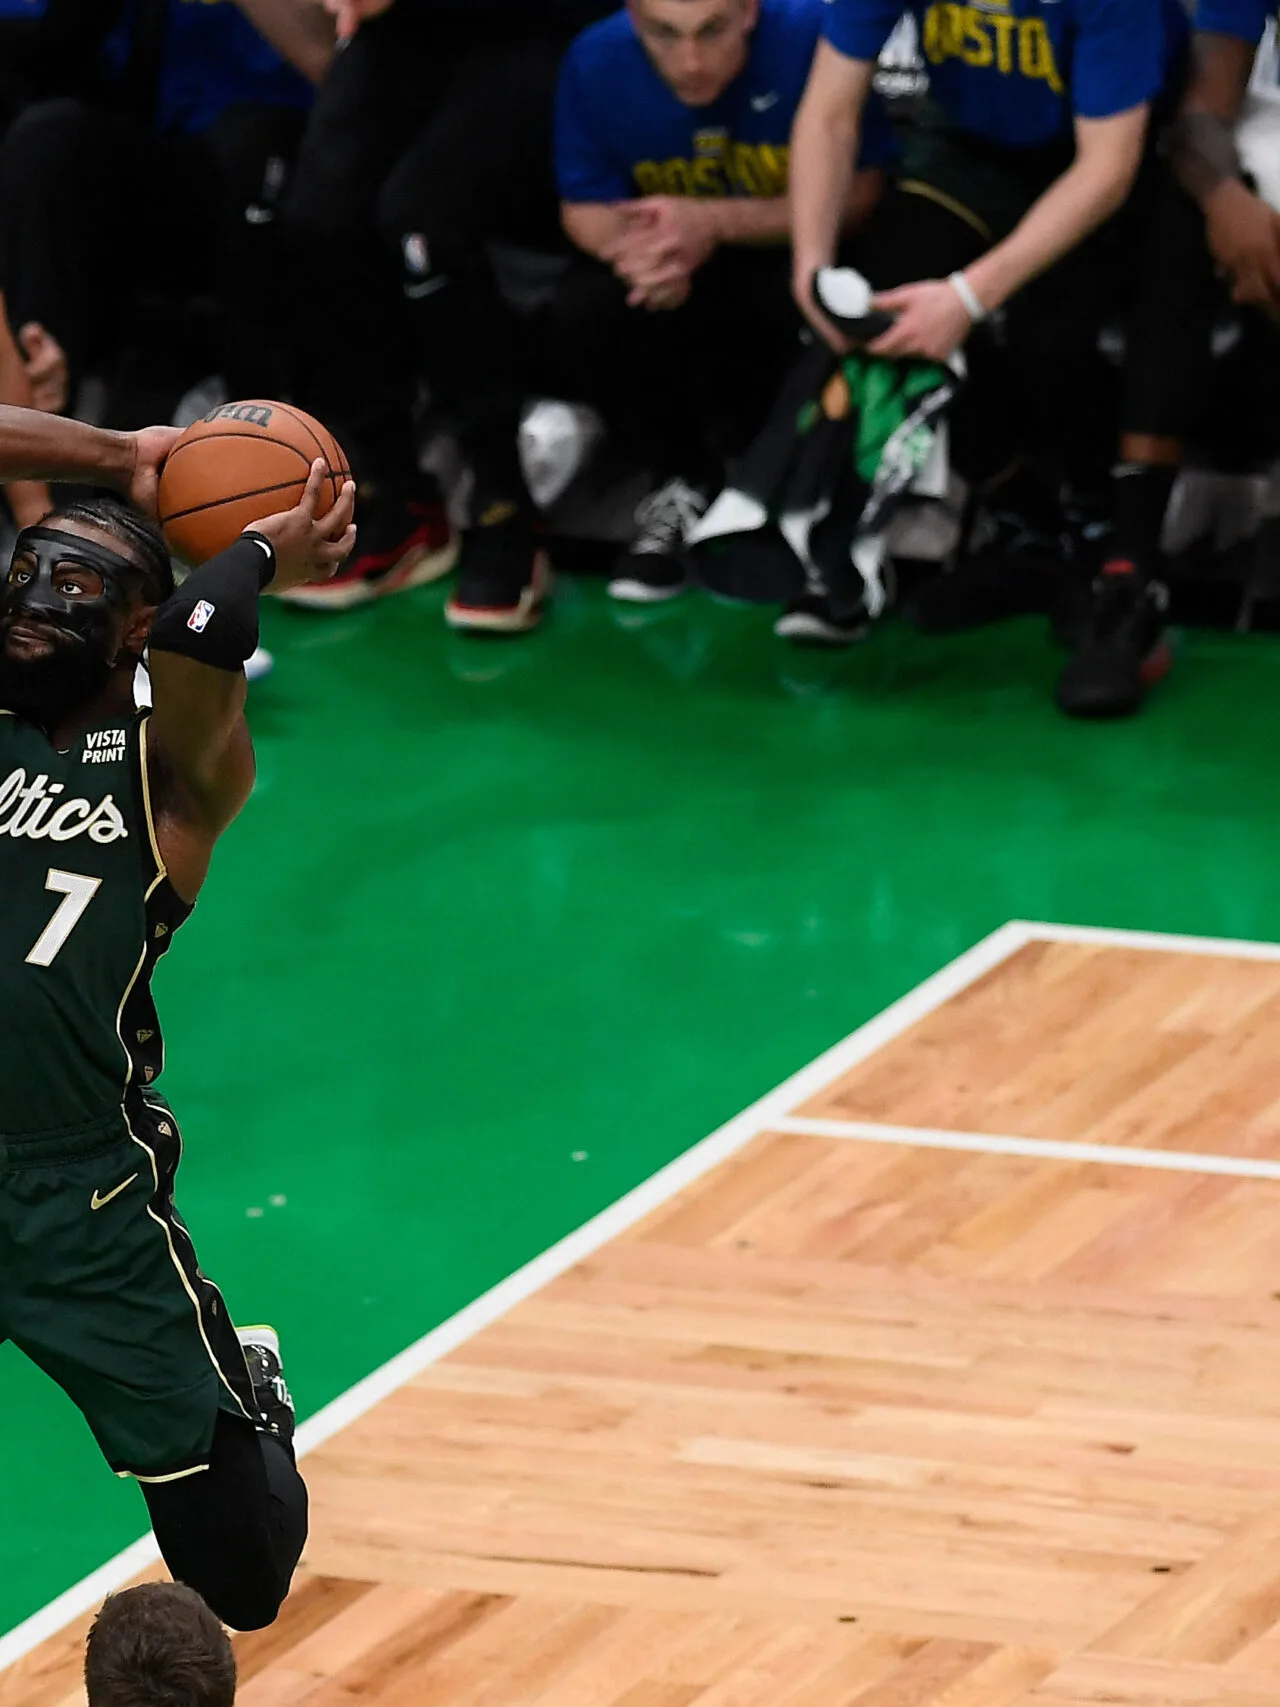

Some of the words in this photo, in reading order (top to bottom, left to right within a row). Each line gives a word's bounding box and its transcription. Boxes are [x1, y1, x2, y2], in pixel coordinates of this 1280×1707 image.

[86, 729, 126, 749] VISTA
[81, 746, 126, 764] PRINT
[24, 868, 104, 968] 7
